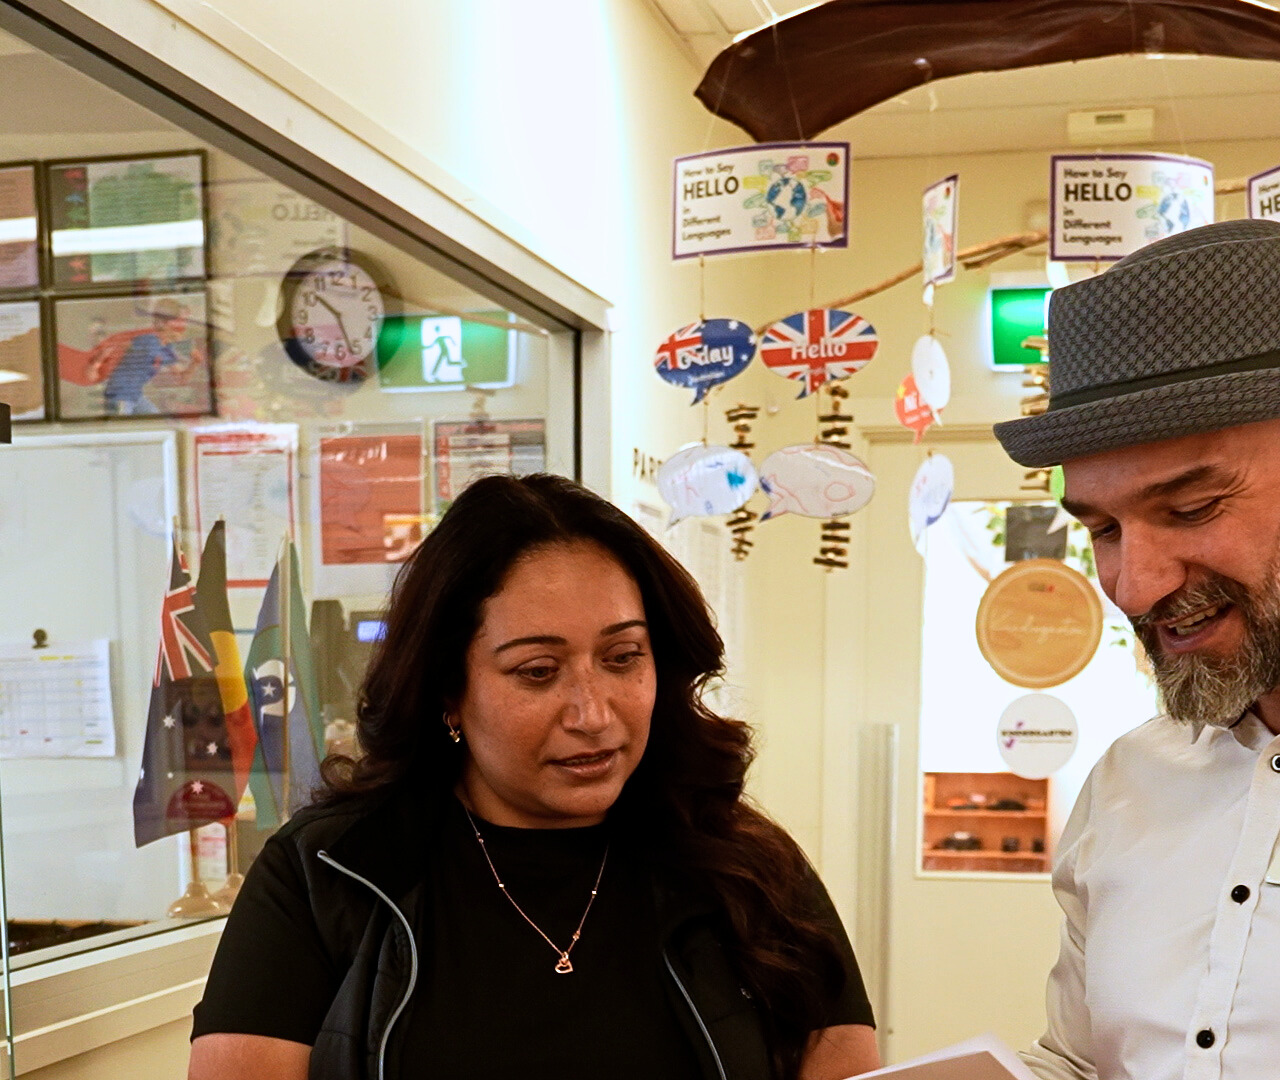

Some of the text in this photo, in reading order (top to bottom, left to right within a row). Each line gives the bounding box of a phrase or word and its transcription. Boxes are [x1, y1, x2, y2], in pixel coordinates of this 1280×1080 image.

[717, 163, 735, 175] Say
[1063, 167, 1128, 181] How to Say
[683, 176, 740, 201] HELLO
[1063, 182, 1133, 202] HELLO
[1063, 219, 1112, 230] Different
[1063, 233, 1123, 246] Languages
[791, 336, 848, 361] Hello
